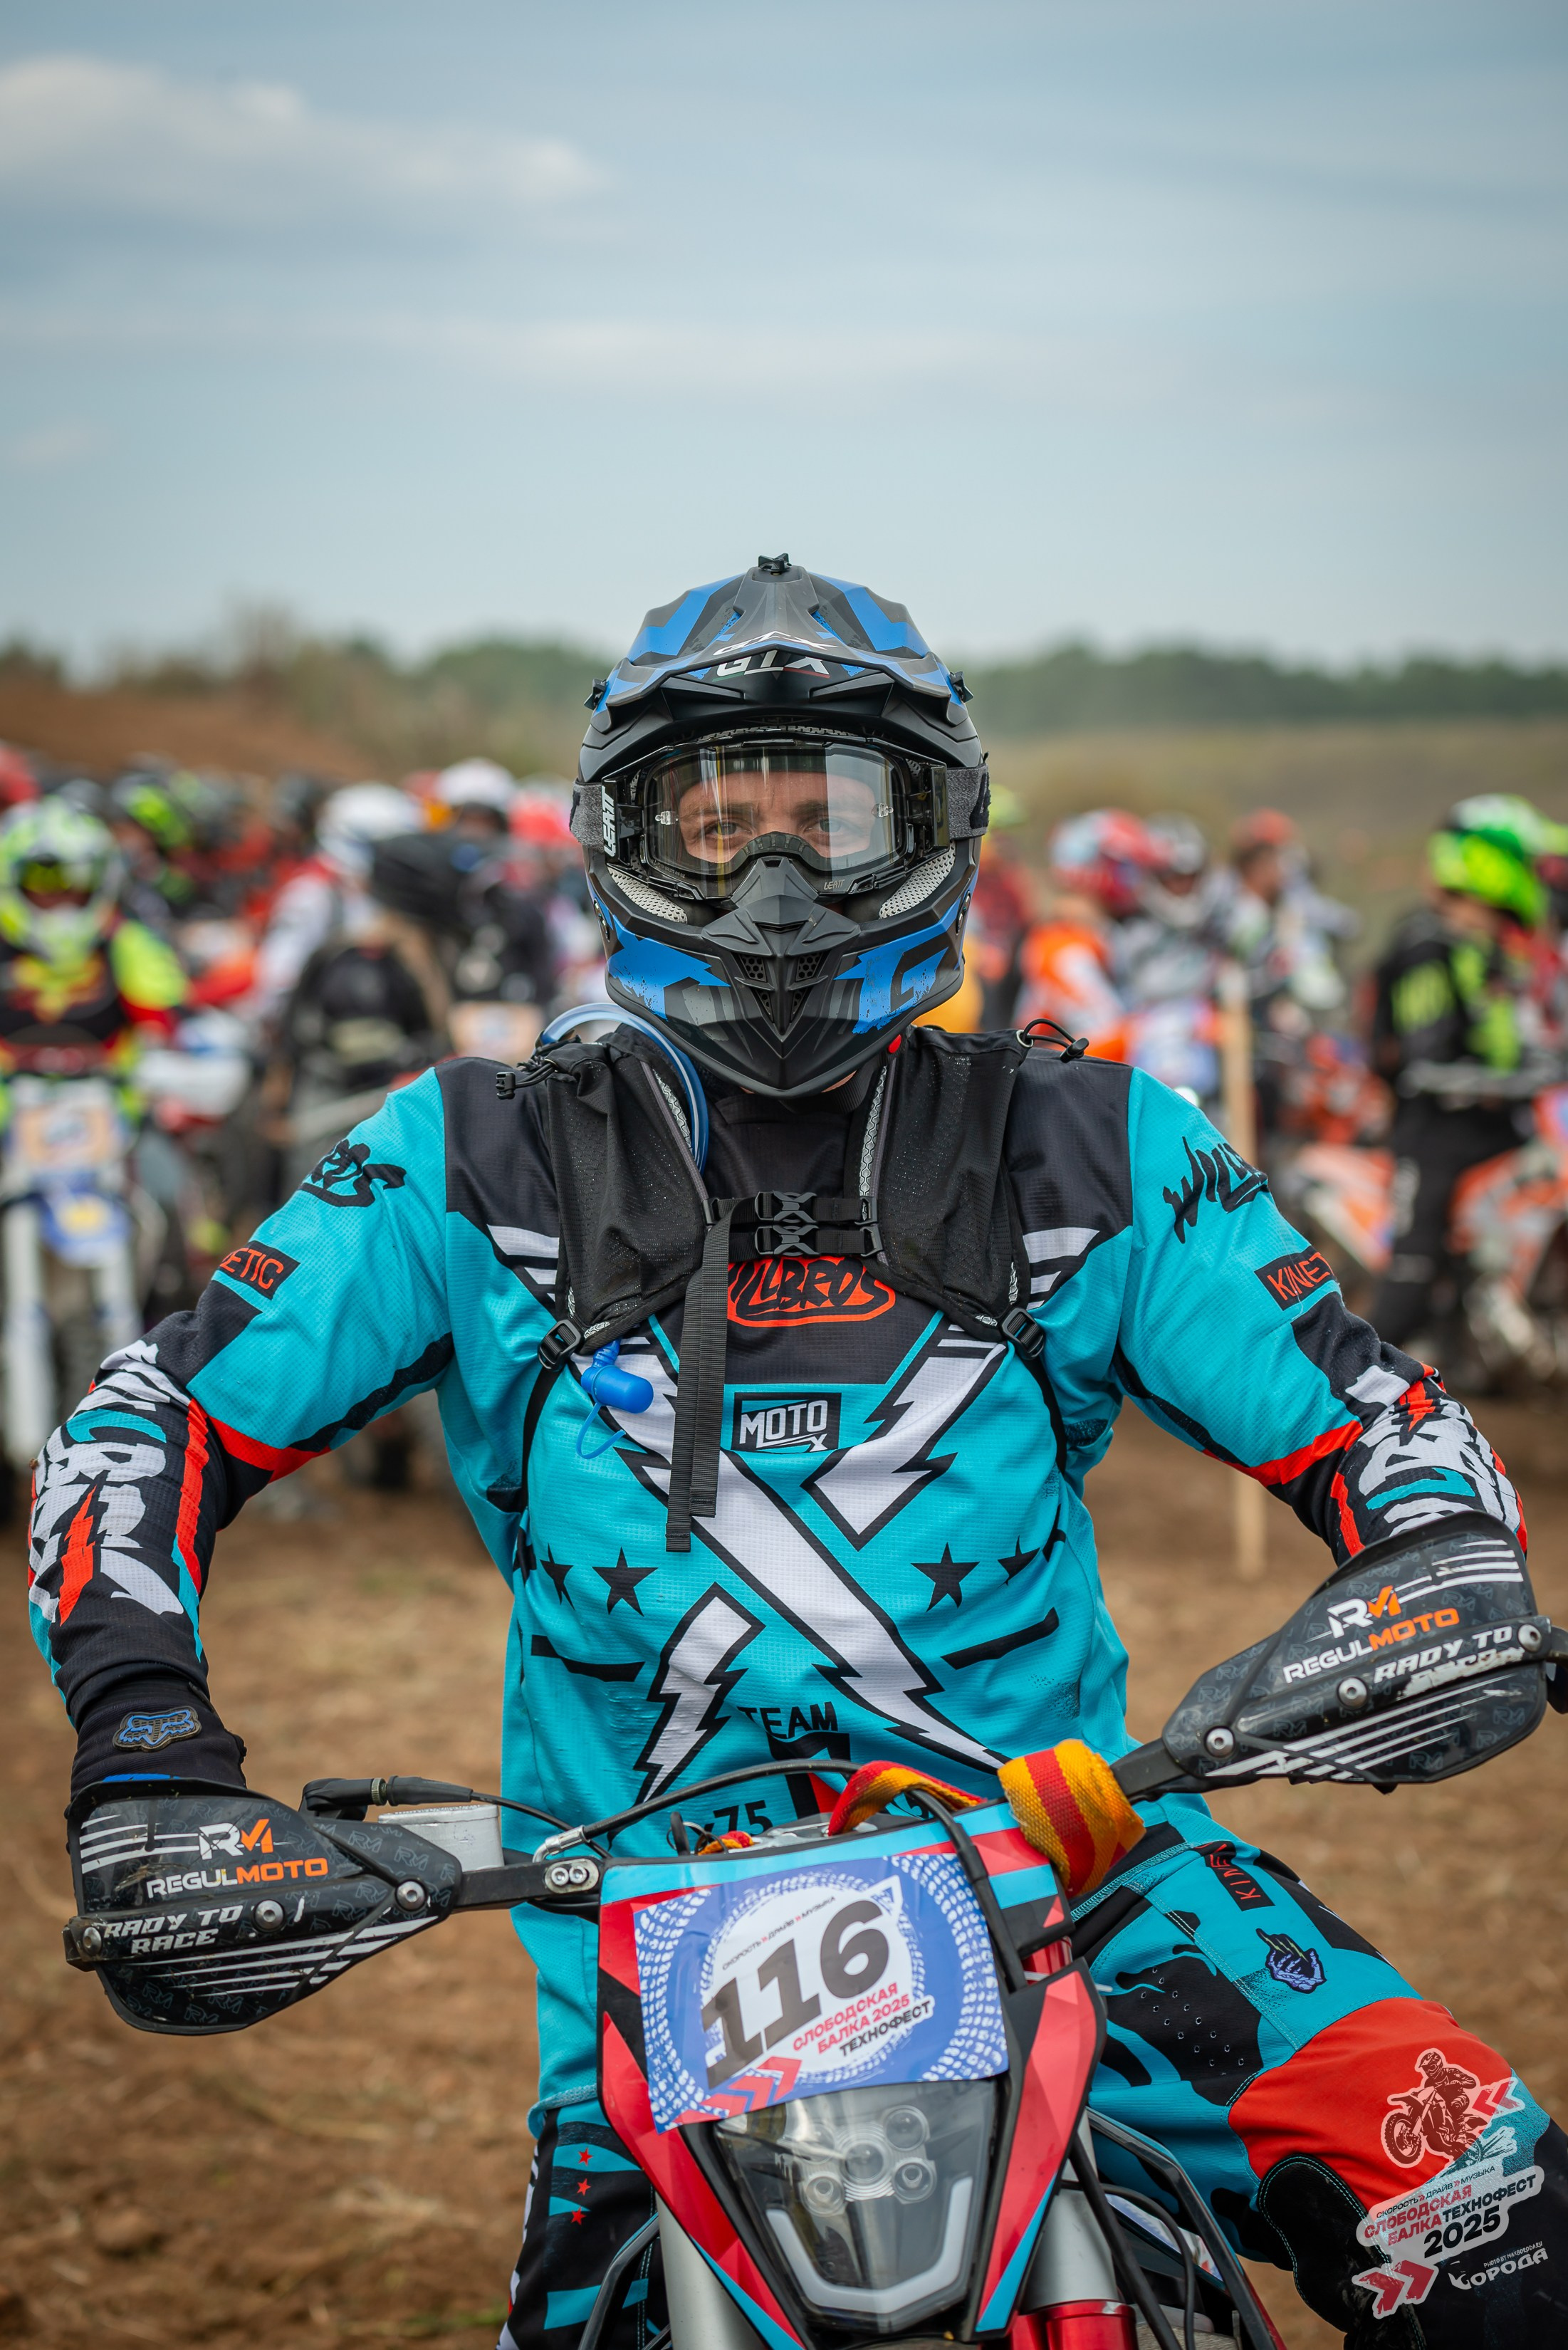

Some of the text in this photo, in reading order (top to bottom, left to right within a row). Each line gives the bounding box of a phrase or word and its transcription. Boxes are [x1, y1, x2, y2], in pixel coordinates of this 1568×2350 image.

[602, 785, 616, 857] LEATT
[823, 879, 845, 890] LEATT
[739, 1400, 828, 1448] MOTO
[1282, 1607, 1460, 1684] REGULMOTO
[737, 1701, 838, 1739] TEAM
[146, 1857, 329, 1899] REGULMOTO
[131, 1928, 219, 1954] RACE
[701, 1899, 889, 2090] 116
[793, 1983, 898, 2051] СЛОБОДСКАЯ
[817, 1994, 910, 2054] БАЛКА 2025
[840, 2000, 930, 2057] ТЕХНОФЕСТ
